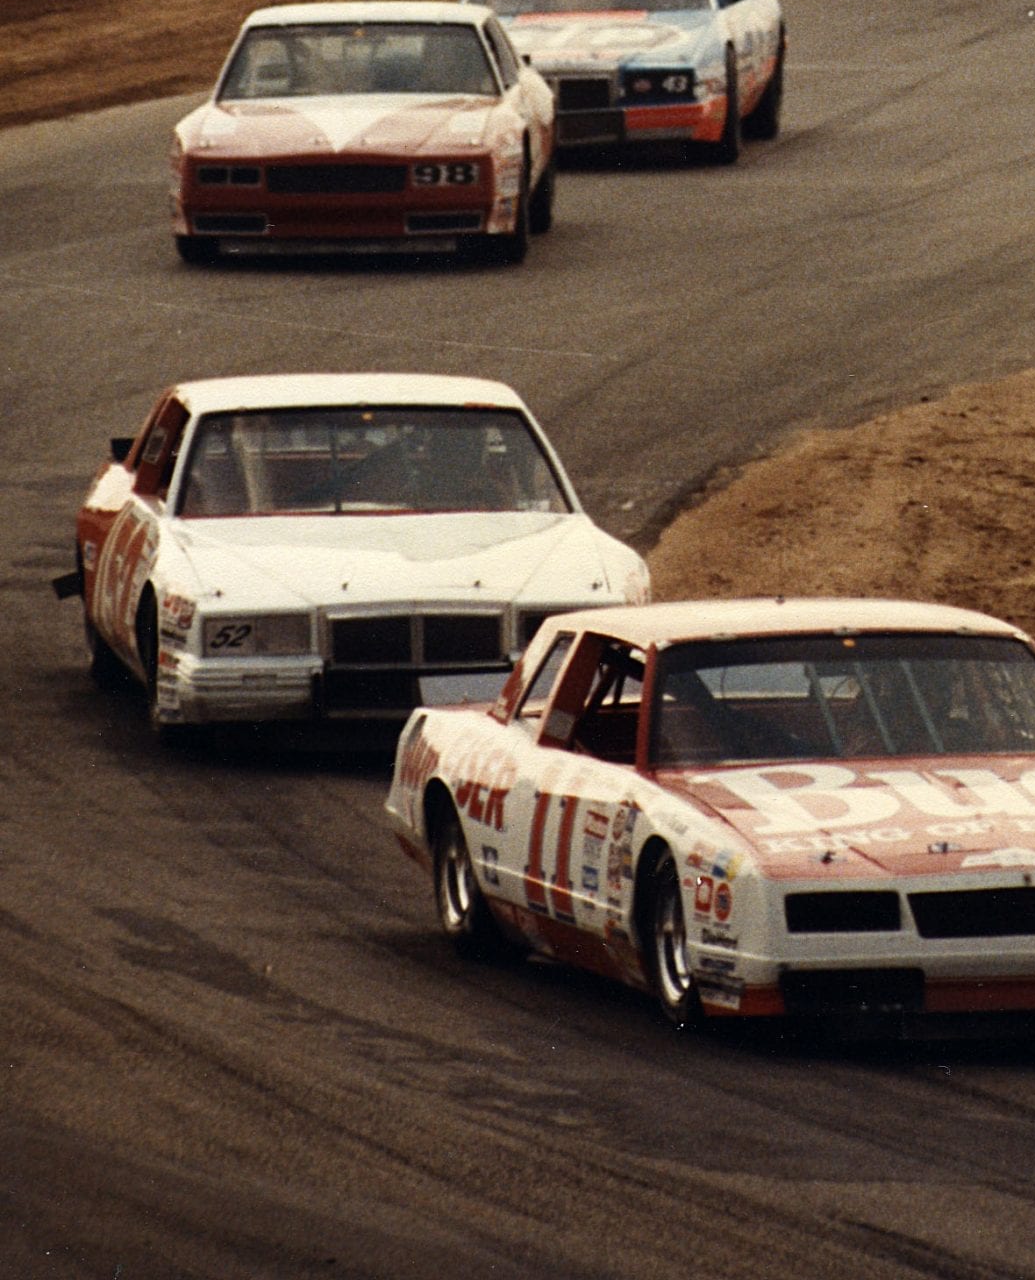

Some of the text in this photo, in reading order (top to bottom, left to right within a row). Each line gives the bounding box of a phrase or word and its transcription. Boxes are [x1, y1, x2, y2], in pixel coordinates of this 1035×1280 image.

[661, 74, 689, 95] 43
[413, 163, 475, 186] 98
[210, 623, 252, 650] 52
[523, 763, 587, 924] 11
[762, 824, 913, 854] KING
[923, 818, 995, 838] OF
